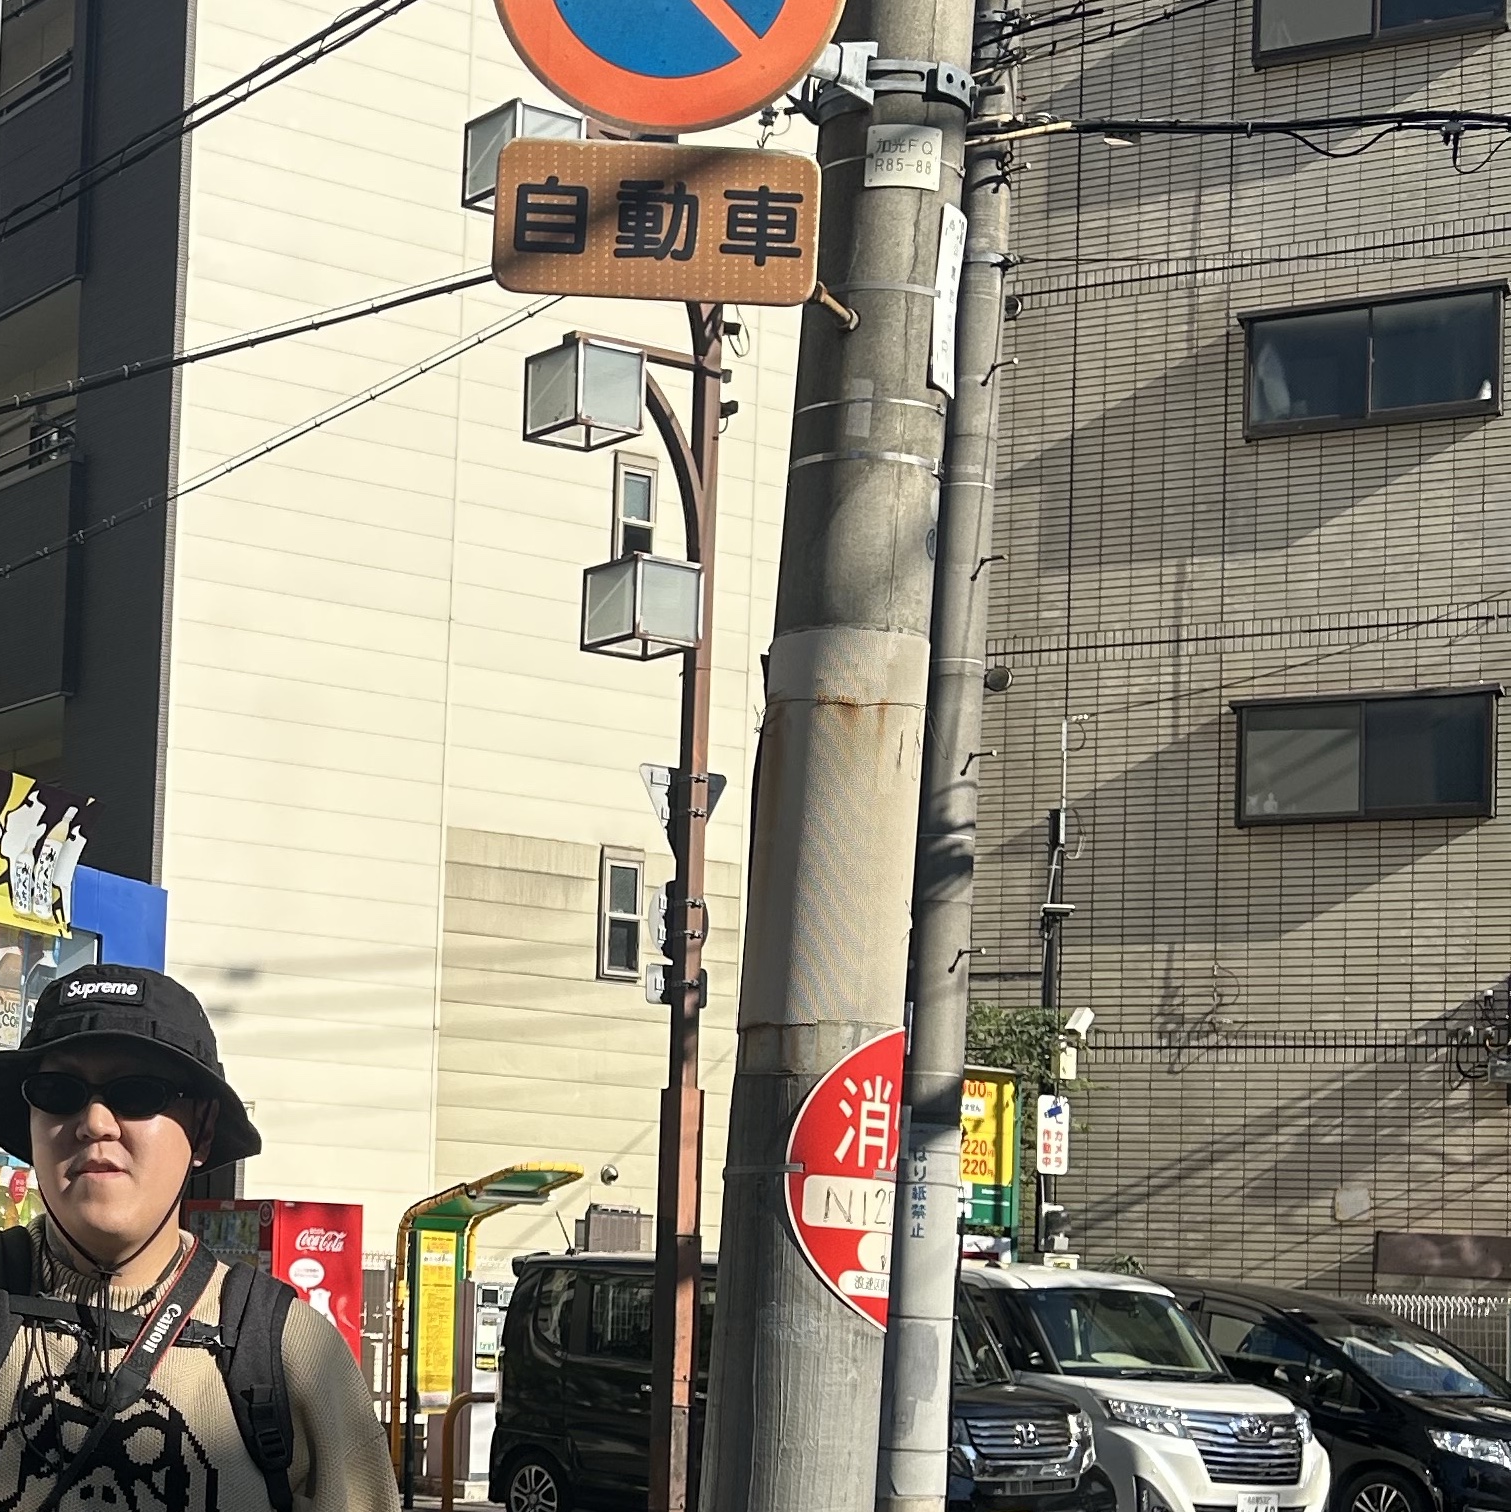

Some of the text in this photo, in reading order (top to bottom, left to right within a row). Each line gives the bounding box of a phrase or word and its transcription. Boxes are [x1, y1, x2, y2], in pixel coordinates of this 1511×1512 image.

[874, 157, 933, 175] R85-88
[513, 175, 804, 267] 自動車
[67, 980, 138, 999] Supreme
[834, 1074, 901, 1170] 消
[1054, 1130, 1064, 1167] カメラ
[910, 1145, 928, 1239] はり紙禁止
[295, 1229, 348, 1253] Coca-Cola
[142, 1303, 182, 1354] Canon
